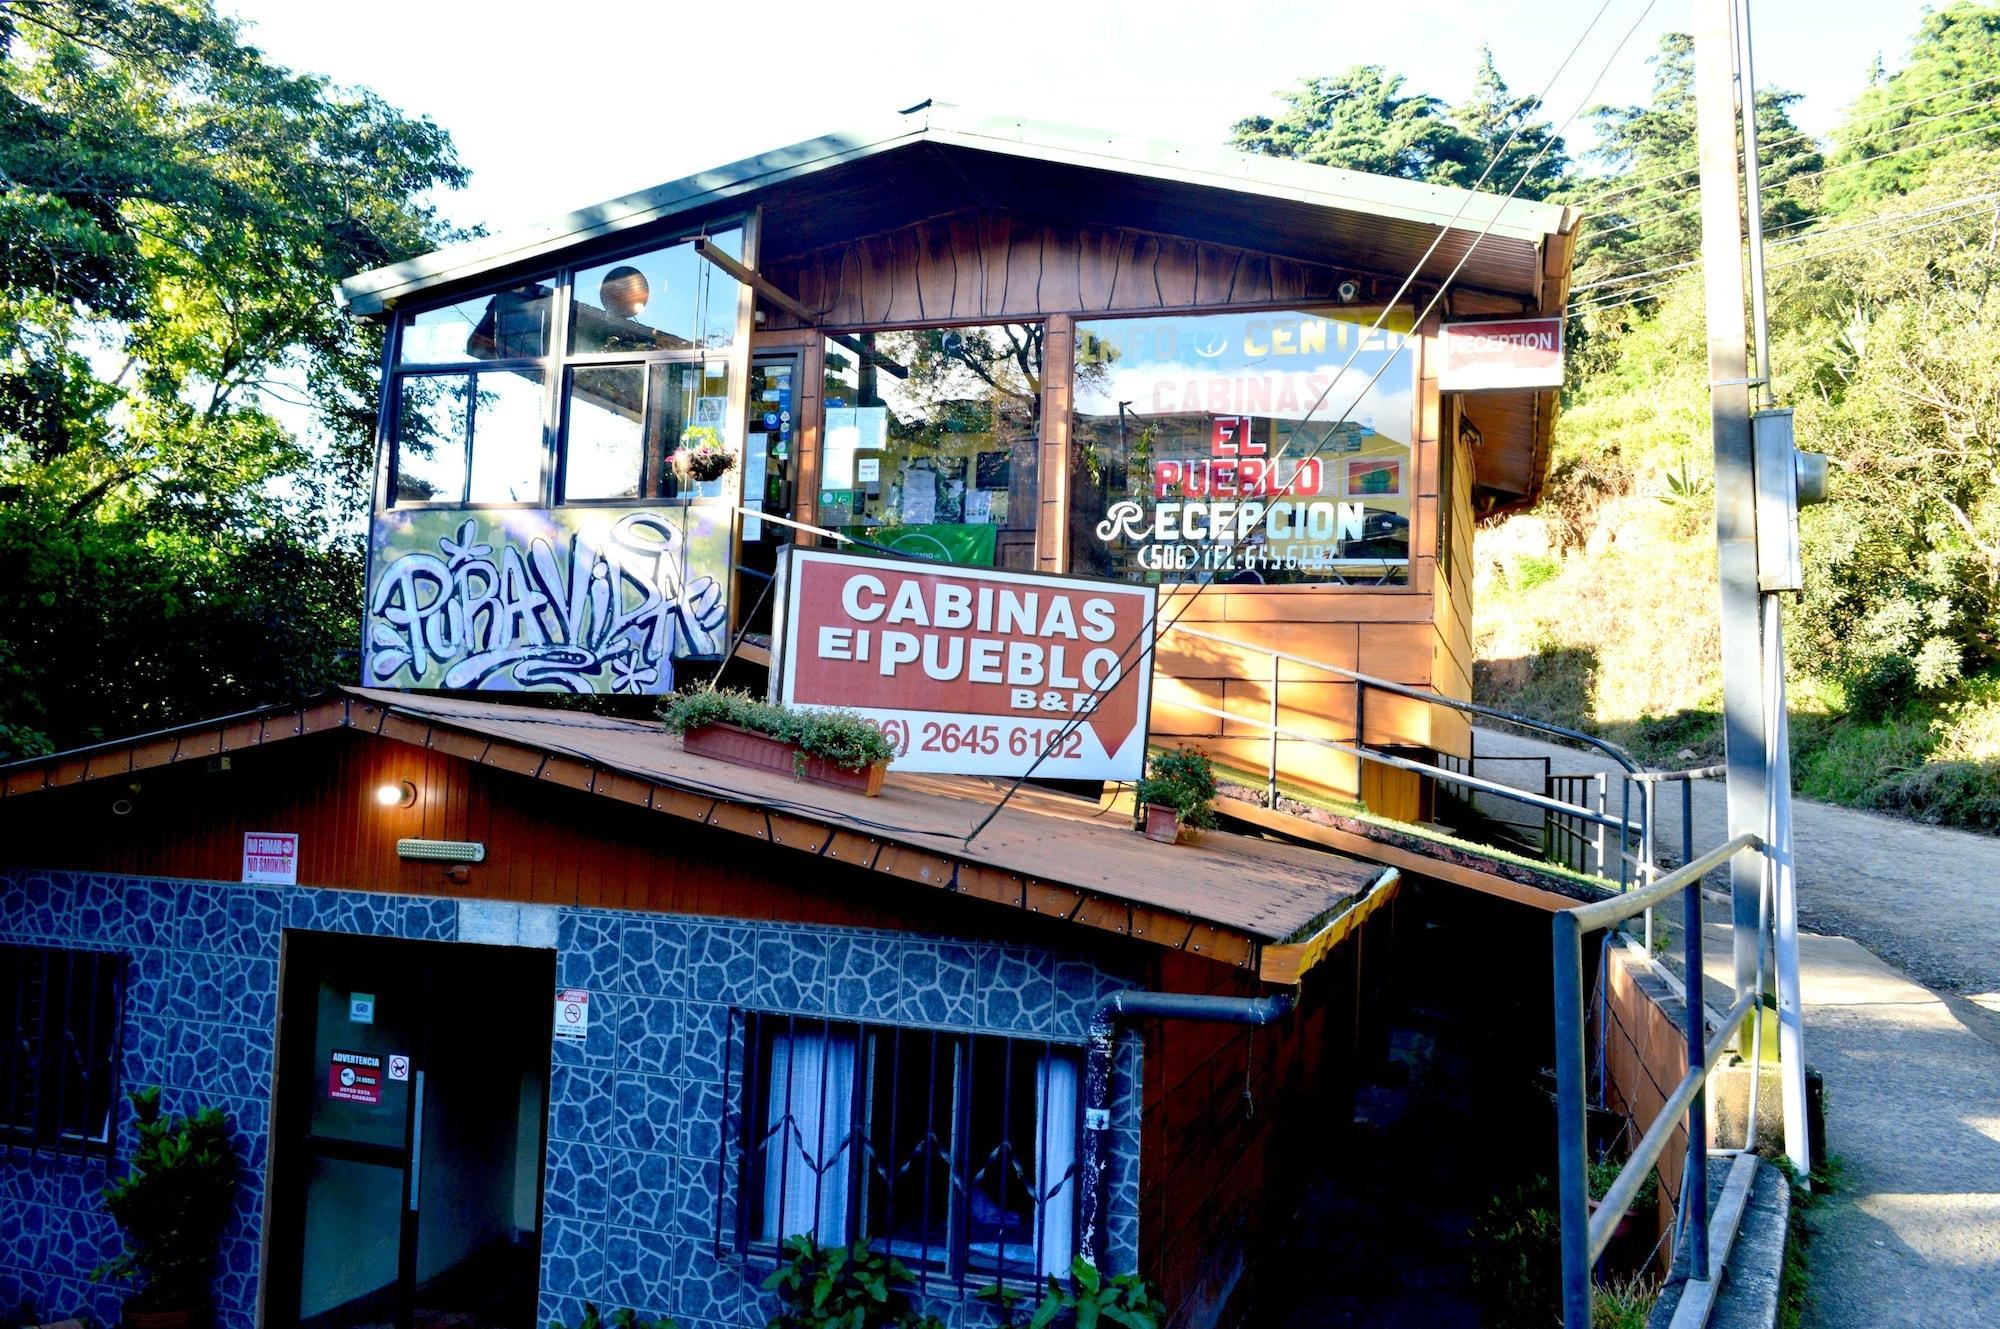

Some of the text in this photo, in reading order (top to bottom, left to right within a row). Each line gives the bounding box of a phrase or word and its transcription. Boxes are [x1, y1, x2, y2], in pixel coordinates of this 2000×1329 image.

[1244, 310, 1413, 357] CENTER
[1449, 332, 1552, 354] RECEPTION
[1152, 374, 1329, 414] CABINAS
[1211, 416, 1266, 456] EL
[1155, 456, 1323, 499] PUEBLO
[1096, 501, 1364, 541] RECEPCION
[841, 574, 1116, 643] CABINAS
[880, 630, 1122, 692] PUEBLO
[1011, 688, 1098, 713] B&B
[921, 722, 999, 755] 2645
[1008, 727, 1083, 759] 6192
[247, 838, 282, 855] NO FUMAR
[247, 857, 291, 873] NO SMOKING
[333, 1053, 380, 1067] ADVERTENCIA
